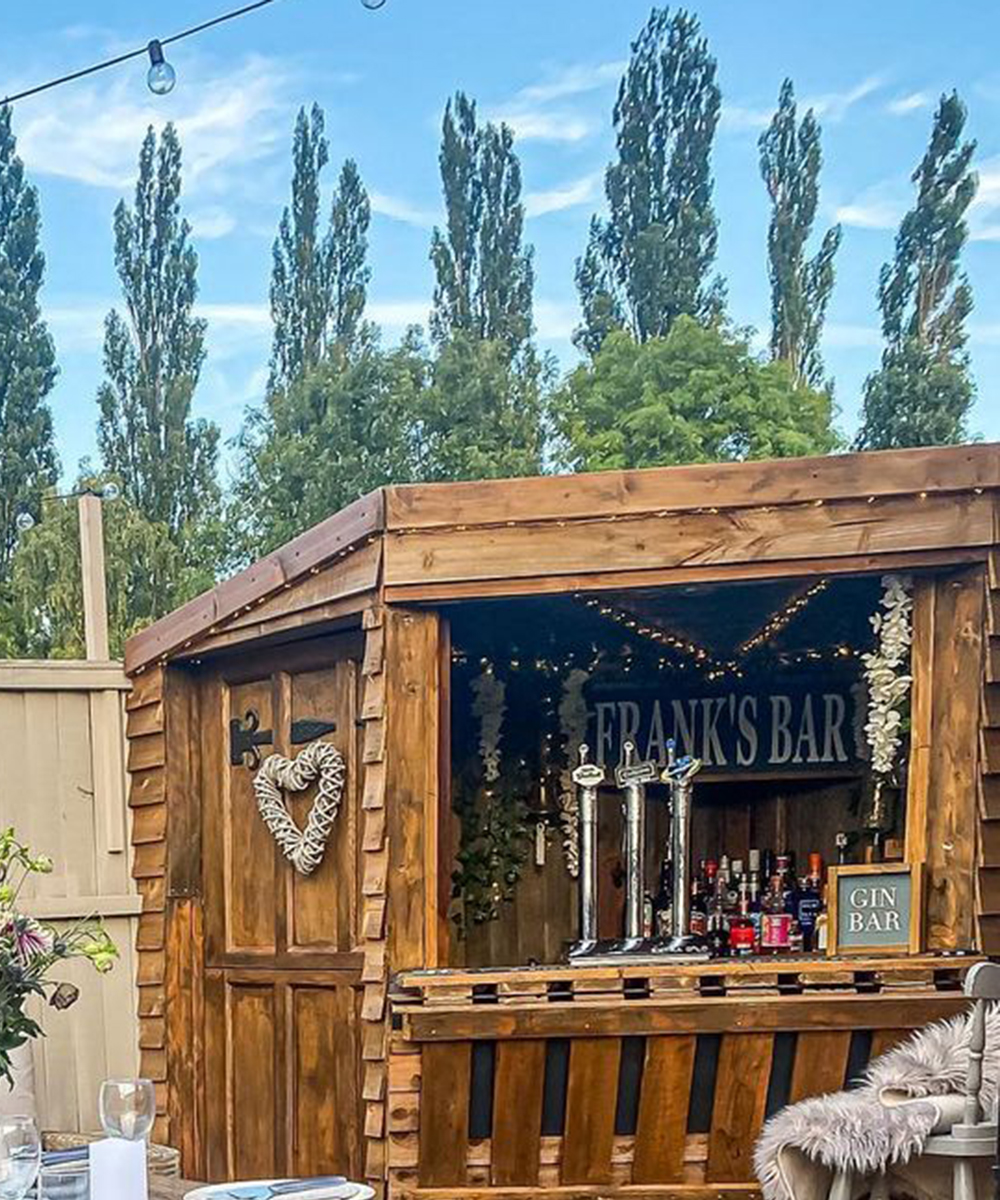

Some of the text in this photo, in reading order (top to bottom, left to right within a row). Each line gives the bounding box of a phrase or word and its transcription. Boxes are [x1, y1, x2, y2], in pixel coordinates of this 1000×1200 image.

[594, 693, 849, 769] FRANK'S BAR
[849, 885, 897, 909] GIN
[848, 909, 901, 933] BAR
